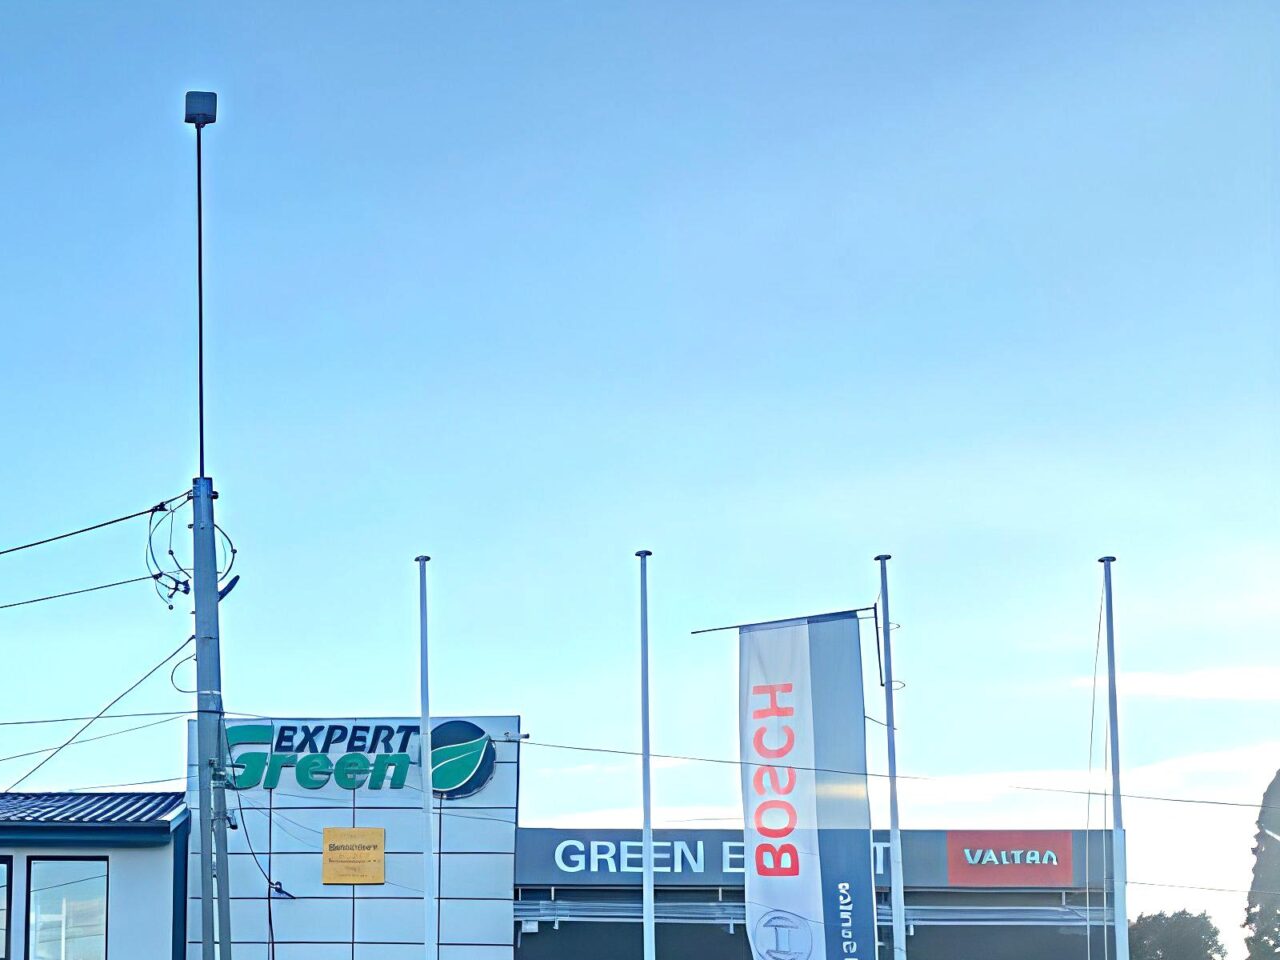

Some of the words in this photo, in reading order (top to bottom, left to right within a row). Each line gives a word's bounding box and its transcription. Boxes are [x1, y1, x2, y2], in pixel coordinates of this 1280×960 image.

[274, 725, 420, 754] EXPERT
[225, 725, 411, 790] Green
[554, 840, 705, 874] GREEN
